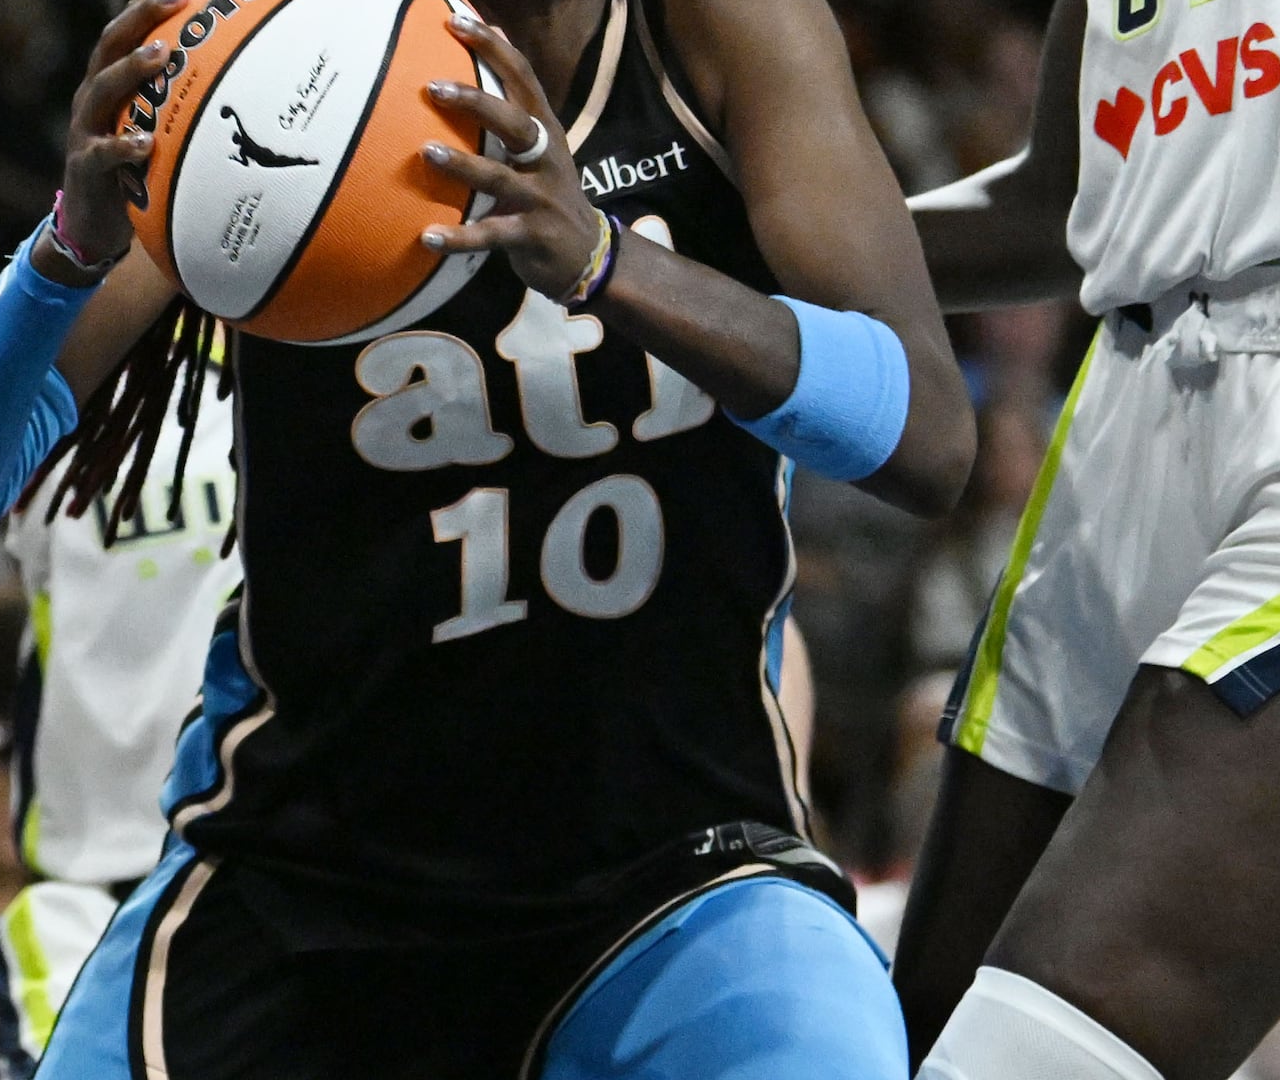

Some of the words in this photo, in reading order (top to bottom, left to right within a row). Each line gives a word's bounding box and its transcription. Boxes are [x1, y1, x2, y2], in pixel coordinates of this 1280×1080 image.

[581, 141, 688, 196] Albert
[221, 195, 248, 251] OFFICIAL
[430, 474, 665, 644] 10
